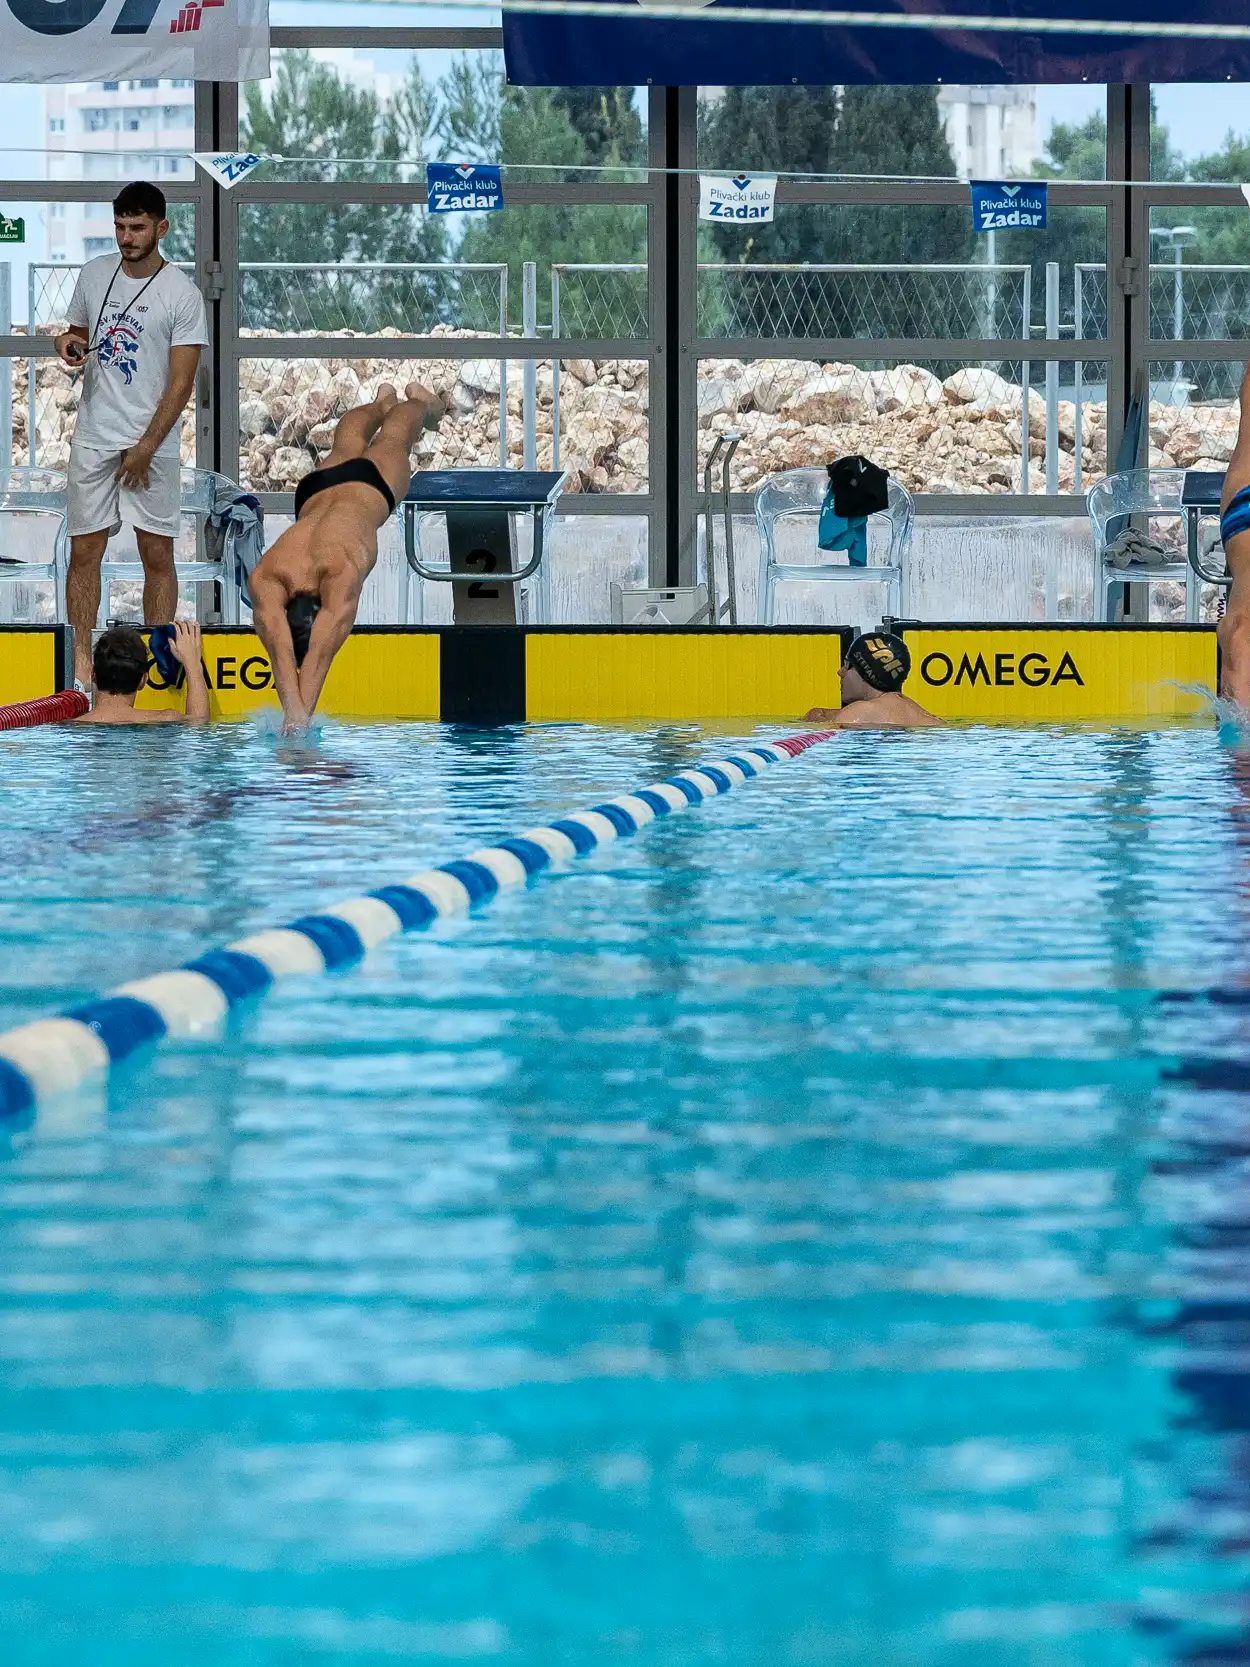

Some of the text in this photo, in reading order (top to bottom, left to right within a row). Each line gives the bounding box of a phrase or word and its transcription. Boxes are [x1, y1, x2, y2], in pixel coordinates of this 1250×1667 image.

[435, 180, 497, 191] Plivački klub
[434, 193, 499, 209] Zadar
[710, 189, 771, 201] Plivački klub
[709, 201, 770, 218] Zadar
[980, 198, 1042, 210] Plivački klub
[980, 210, 1042, 229] Zadar
[466, 549, 498, 598] 2
[145, 656, 276, 690] OEG
[920, 651, 1085, 687] OMEGA
